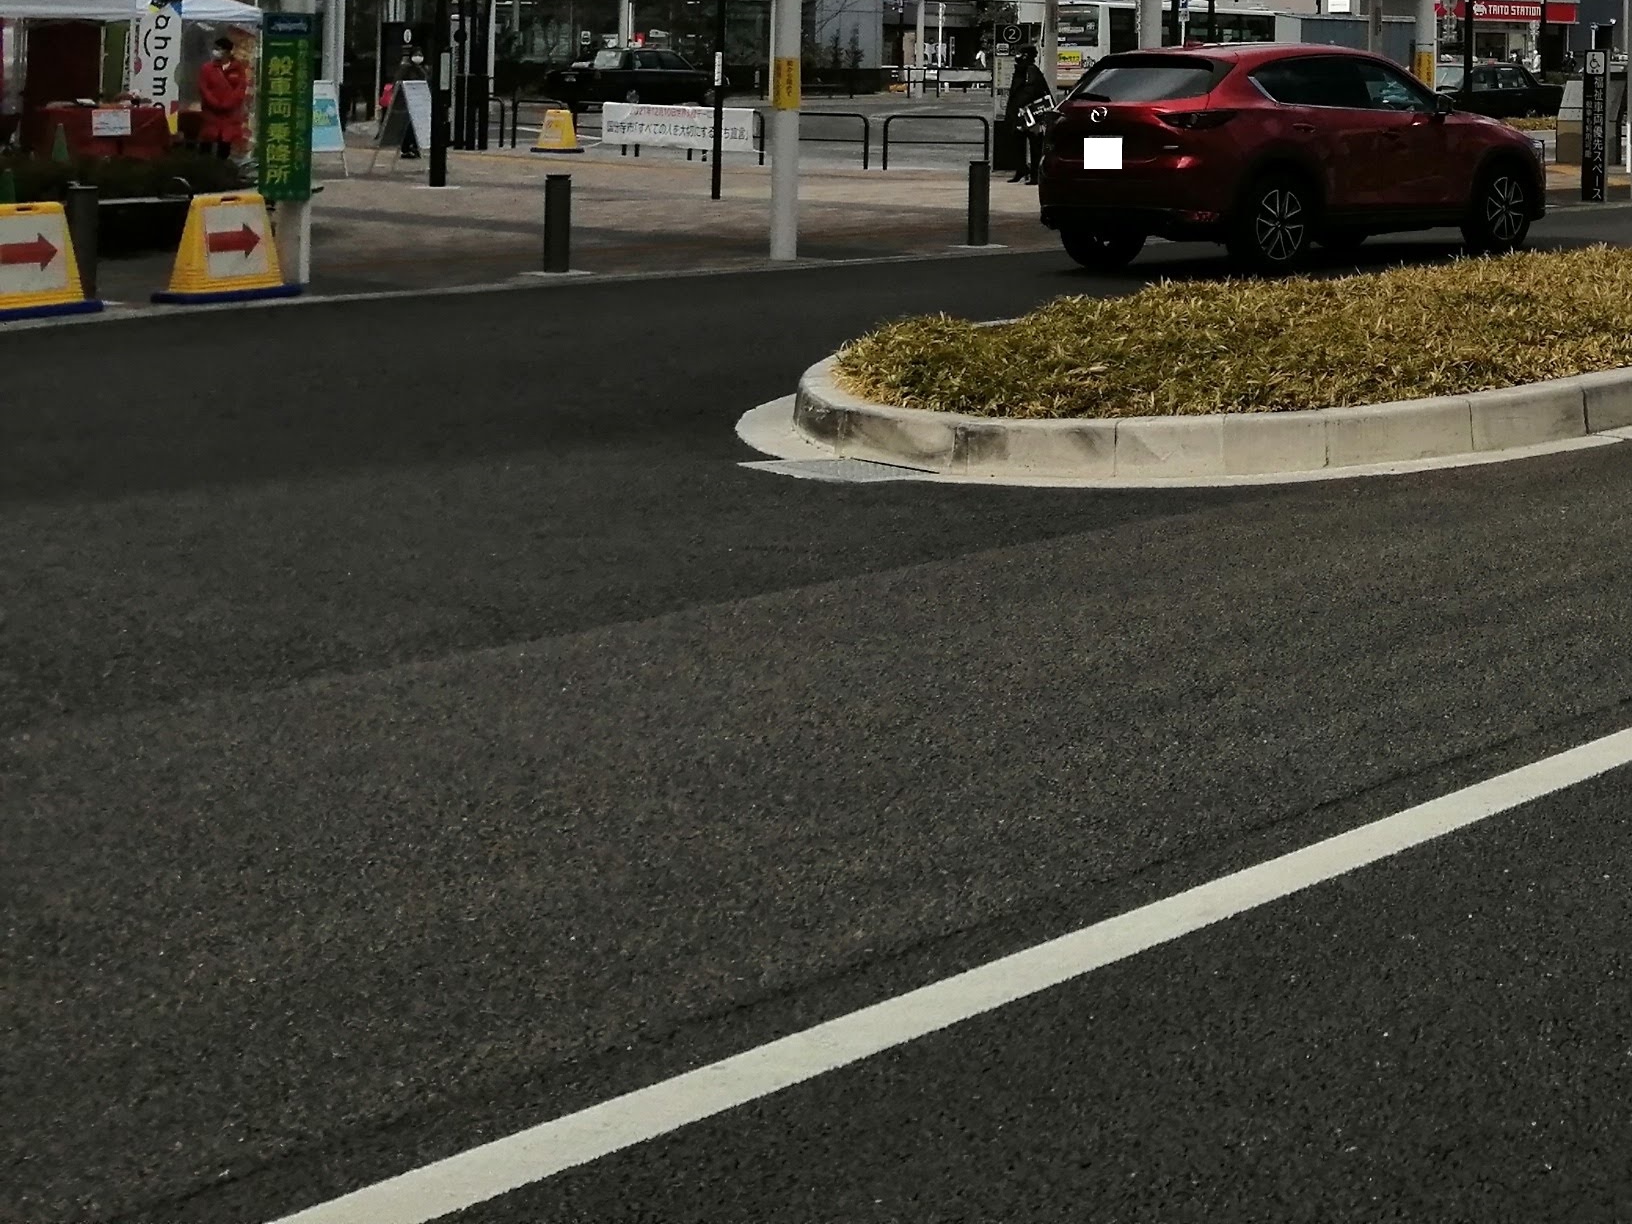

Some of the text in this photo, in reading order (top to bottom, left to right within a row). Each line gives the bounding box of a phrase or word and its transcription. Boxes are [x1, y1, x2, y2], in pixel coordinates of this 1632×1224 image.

[1489, 5, 1541, 16] TAITO STATION
[607, 120, 749, 140] 国分寺市「すべての人を大切にするち宣言」
[1593, 77, 1604, 200] 福祉車両優先スペース
